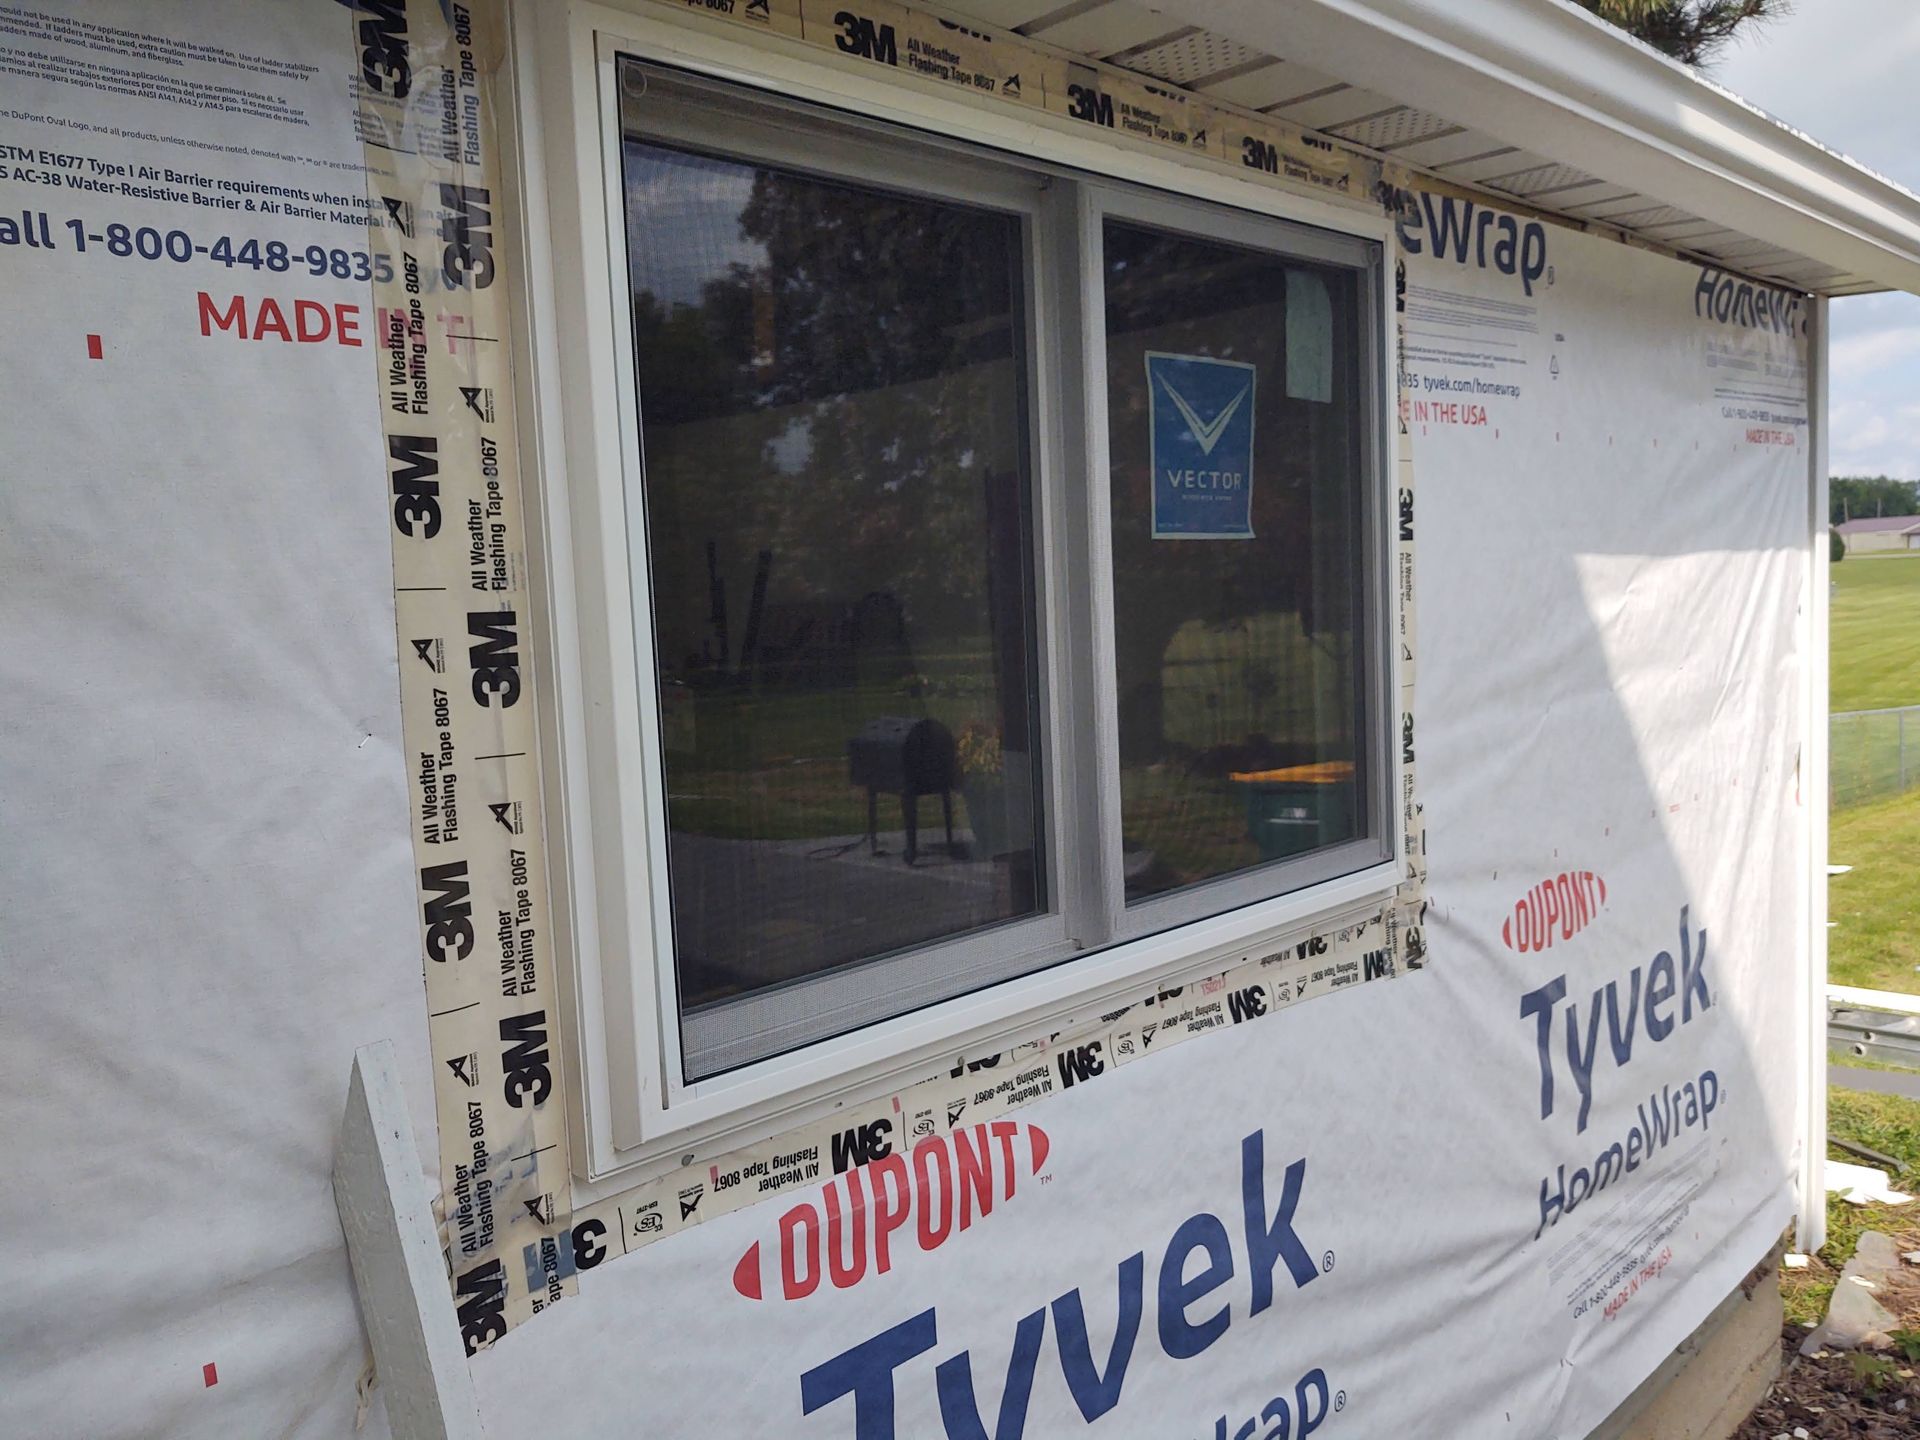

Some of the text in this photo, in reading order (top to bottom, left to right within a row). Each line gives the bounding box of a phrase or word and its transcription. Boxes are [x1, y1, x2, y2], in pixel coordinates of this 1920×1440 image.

[359, 0, 412, 99] 3M
[833, 11, 898, 67] 3M
[453, 3, 481, 166] Flashing Tape 8067
[1067, 84, 1114, 128] 3M
[12, 111, 45, 124] DuPont
[46, 116, 66, 127] Oval
[68, 119, 91, 133] Logo,
[92, 125, 107, 133] and
[109, 126, 120, 135] all
[121, 130, 159, 143] products,
[160, 135, 185, 145] unless
[186, 138, 223, 151] otherwise
[225, 145, 249, 157] noted,
[250, 148, 279, 160] denoted
[280, 153, 295, 162] with
[439, 65, 461, 163] All Weather
[39, 151, 83, 170] E1677
[87, 158, 125, 177] Type
[129, 164, 134, 176] I
[137, 165, 161, 180] Air
[164, 168, 213, 187] Barrier
[217, 178, 310, 199] requirements
[312, 189, 349, 206] when
[1241, 136, 1278, 174] 3M
[12, 167, 62, 187] AC-38
[65, 175, 188, 205] Water-Resistive
[192, 194, 240, 211] Barrier
[244, 200, 256, 214] &
[259, 202, 280, 217] Air
[283, 205, 326, 223] Barrier
[330, 211, 384, 230] Material
[64, 218, 395, 284] 1-800-448-9835
[439, 183, 495, 290] 3M
[403, 251, 421, 295] 8067
[197, 290, 363, 347] MADE
[407, 298, 425, 344] Tape
[388, 314, 409, 415] All Weather
[410, 344, 428, 415] Flashing
[1423, 375, 1521, 400] tyvek.com/homewrap
[1414, 401, 1488, 426] IN THE USA
[480, 437, 498, 477] 8067
[1167, 469, 1243, 490] VECTOR
[388, 435, 442, 540] 3M
[485, 481, 503, 520] Tape
[1399, 487, 1414, 542] 3M
[467, 499, 488, 591] All Weather
[489, 523, 507, 591] Flashing
[466, 611, 521, 709] 3M
[433, 688, 450, 727] 8067
[438, 731, 455, 770] Tape
[419, 752, 441, 845] All Weather
[442, 773, 459, 842] Flashing
[510, 849, 529, 891] 8067
[420, 860, 475, 963] 3M
[515, 891, 532, 927] Tape
[1515, 871, 1598, 953] DUPONT
[498, 910, 518, 997] All Weather
[518, 928, 536, 995] Flashing
[1161, 1001, 1221, 1030] Flashing Tape 8067
[1187, 1013, 1224, 1033] All Weather
[1227, 984, 1267, 1024] 3M
[1520, 904, 1711, 1136] Tyvek
[499, 1009, 552, 1109] 3M
[1016, 1065, 1050, 1086] Flashing
[1057, 1041, 1104, 1089] 3M
[973, 1090, 995, 1107] 8067
[995, 1080, 1016, 1095] Tape
[1007, 1078, 1053, 1106] All Weather
[467, 1101, 485, 1139] 8067
[831, 1118, 893, 1176] 3M
[470, 1142, 489, 1179] Tape
[713, 1171, 741, 1193] 8067
[742, 1162, 770, 1179] Tape
[758, 1162, 819, 1193] All Weather
[772, 1146, 818, 1169] Flashing
[1534, 1069, 1719, 1241] HomeWrap
[454, 1165, 477, 1253] All Weather
[474, 1179, 494, 1248] Flashing
[779, 1121, 1018, 1300] DUPONT
[540, 1237, 559, 1274] 8067
[456, 1258, 507, 1358] 3M
[800, 1128, 1320, 1440] Tyvek
